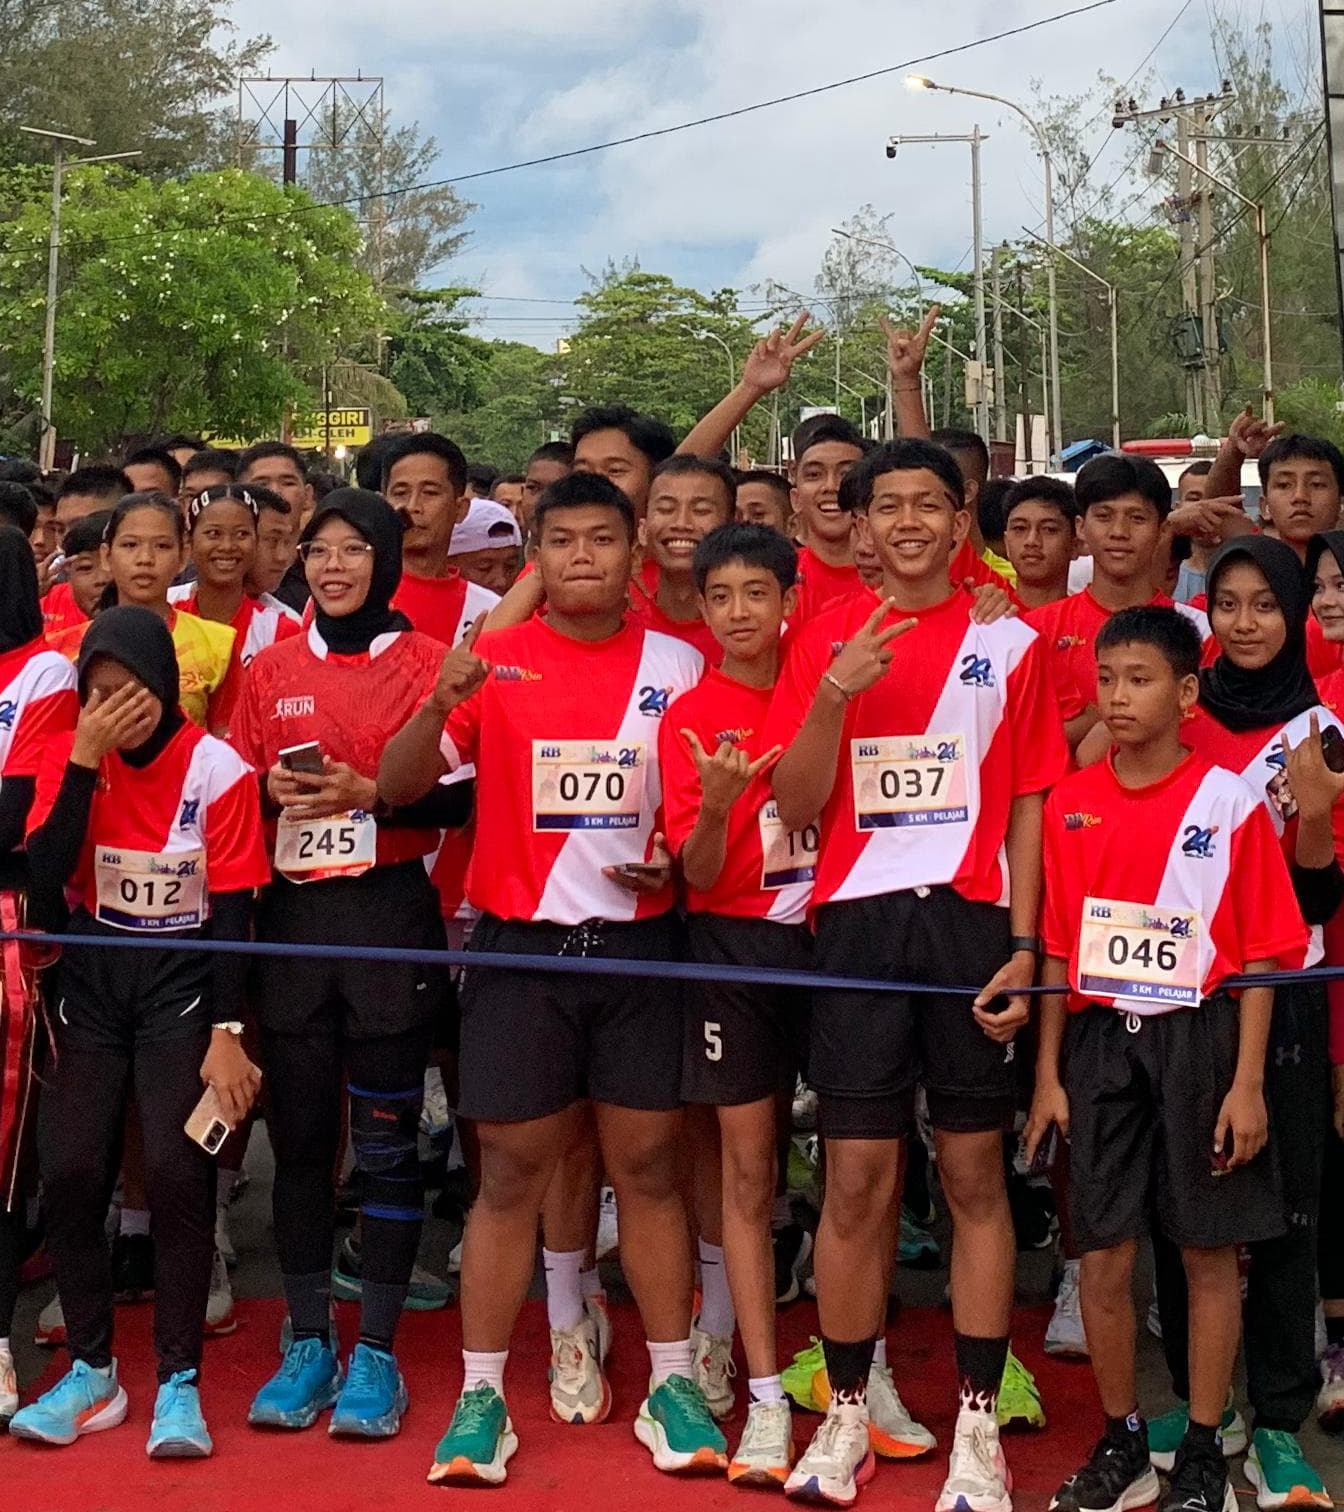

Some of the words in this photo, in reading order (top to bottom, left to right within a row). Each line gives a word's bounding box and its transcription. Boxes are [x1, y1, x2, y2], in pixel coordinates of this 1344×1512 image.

[283, 700, 315, 717] RUN
[541, 747, 561, 758] RB
[858, 745, 879, 757] RB
[560, 772, 624, 801] 070
[880, 767, 945, 799] 037
[591, 817, 603, 826] KM
[609, 816, 637, 826] PELAJAR
[915, 813, 928, 821] KM
[934, 811, 965, 821] PELAJAR
[299, 827, 356, 859] 245
[120, 878, 181, 906] 012
[1090, 905, 1111, 918] RB
[1108, 935, 1177, 971] 046
[1132, 984, 1138, 993] 5
[1139, 985, 1152, 994] KM
[1158, 988, 1193, 999] PELAJAR
[704, 1020, 723, 1062] 5
